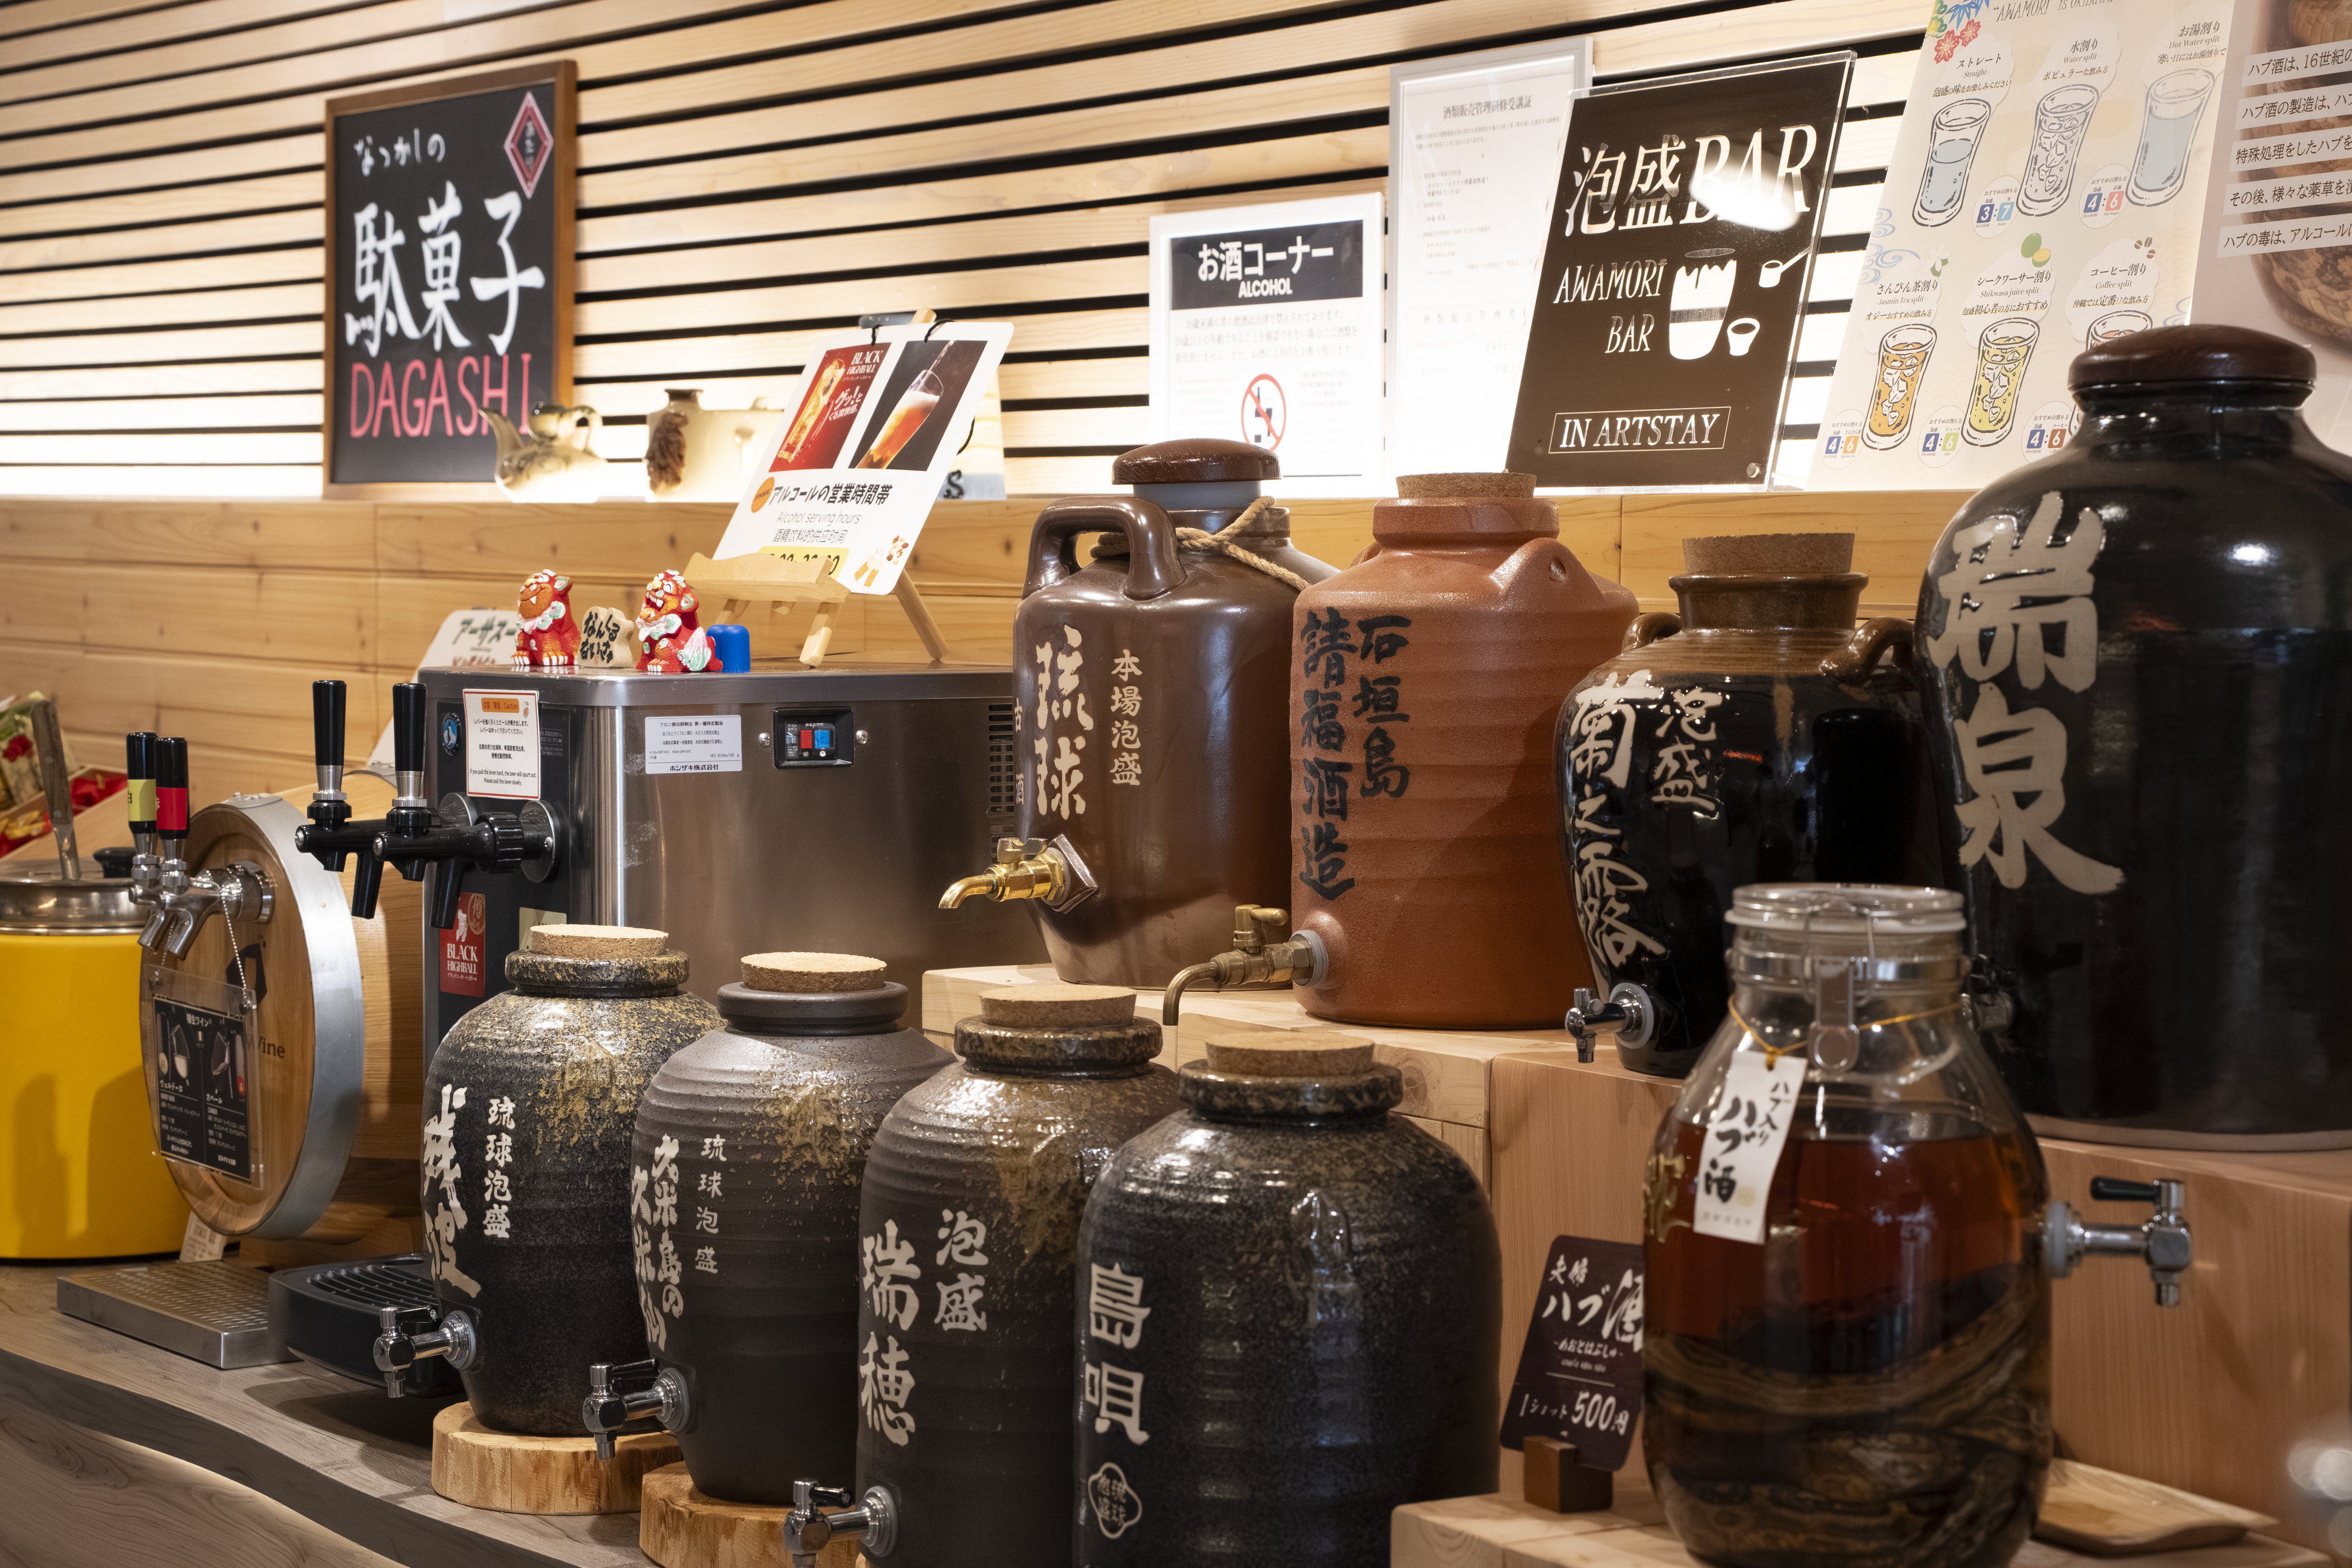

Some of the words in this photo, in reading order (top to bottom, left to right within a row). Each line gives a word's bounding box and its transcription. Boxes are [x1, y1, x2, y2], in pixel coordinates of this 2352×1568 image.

[2069, 38, 2098, 54] 水割り
[2177, 21, 2220, 37] お湯割り
[1956, 53, 2002, 69] ストレート
[345, 180, 546, 357] 駄菓子
[1198, 235, 1334, 282] お酒コーナー
[1977, 270, 2051, 287] シークワーサー割り
[2090, 263, 2146, 276] コーヒー割り
[1238, 278, 1293, 299] ALCOHOL
[1877, 279, 1938, 295] さんぴん茶割り
[2095, 280, 2117, 289] Coffee
[2117, 280, 2132, 290] split
[1605, 313, 1655, 354] BAR
[847, 364, 876, 375] HIGHBALL
[851, 350, 883, 365] BLACK
[350, 353, 532, 438] DAGASHI
[1560, 419, 1591, 449] IN
[1593, 413, 1720, 446] ARTSTAY
[769, 483, 893, 506] アルコールの営業時間帯
[775, 510, 806, 523] Alcohol
[807, 511, 836, 527] serving
[836, 511, 861, 524] hours
[1353, 615, 1411, 798] 石垣島
[1926, 490, 2126, 895] 瑞泉
[1110, 649, 1142, 785] 本場泡盛
[1299, 606, 1358, 901] 請福酒造
[1651, 686, 1723, 811] 泡盛
[1570, 669, 1671, 968] 菊之露
[447, 943, 478, 962] BLACK
[447, 960, 478, 974] HIGHBALL
[483, 1096, 516, 1239] 琉球泡盛
[1705, 1095, 1757, 1203] ハブ酒
[695, 1134, 727, 1274] 琉球泡盛
[652, 1134, 684, 1319] 久米島の
[934, 1209, 989, 1331] 泡盛
[860, 1219, 921, 1446] 瑞穂
